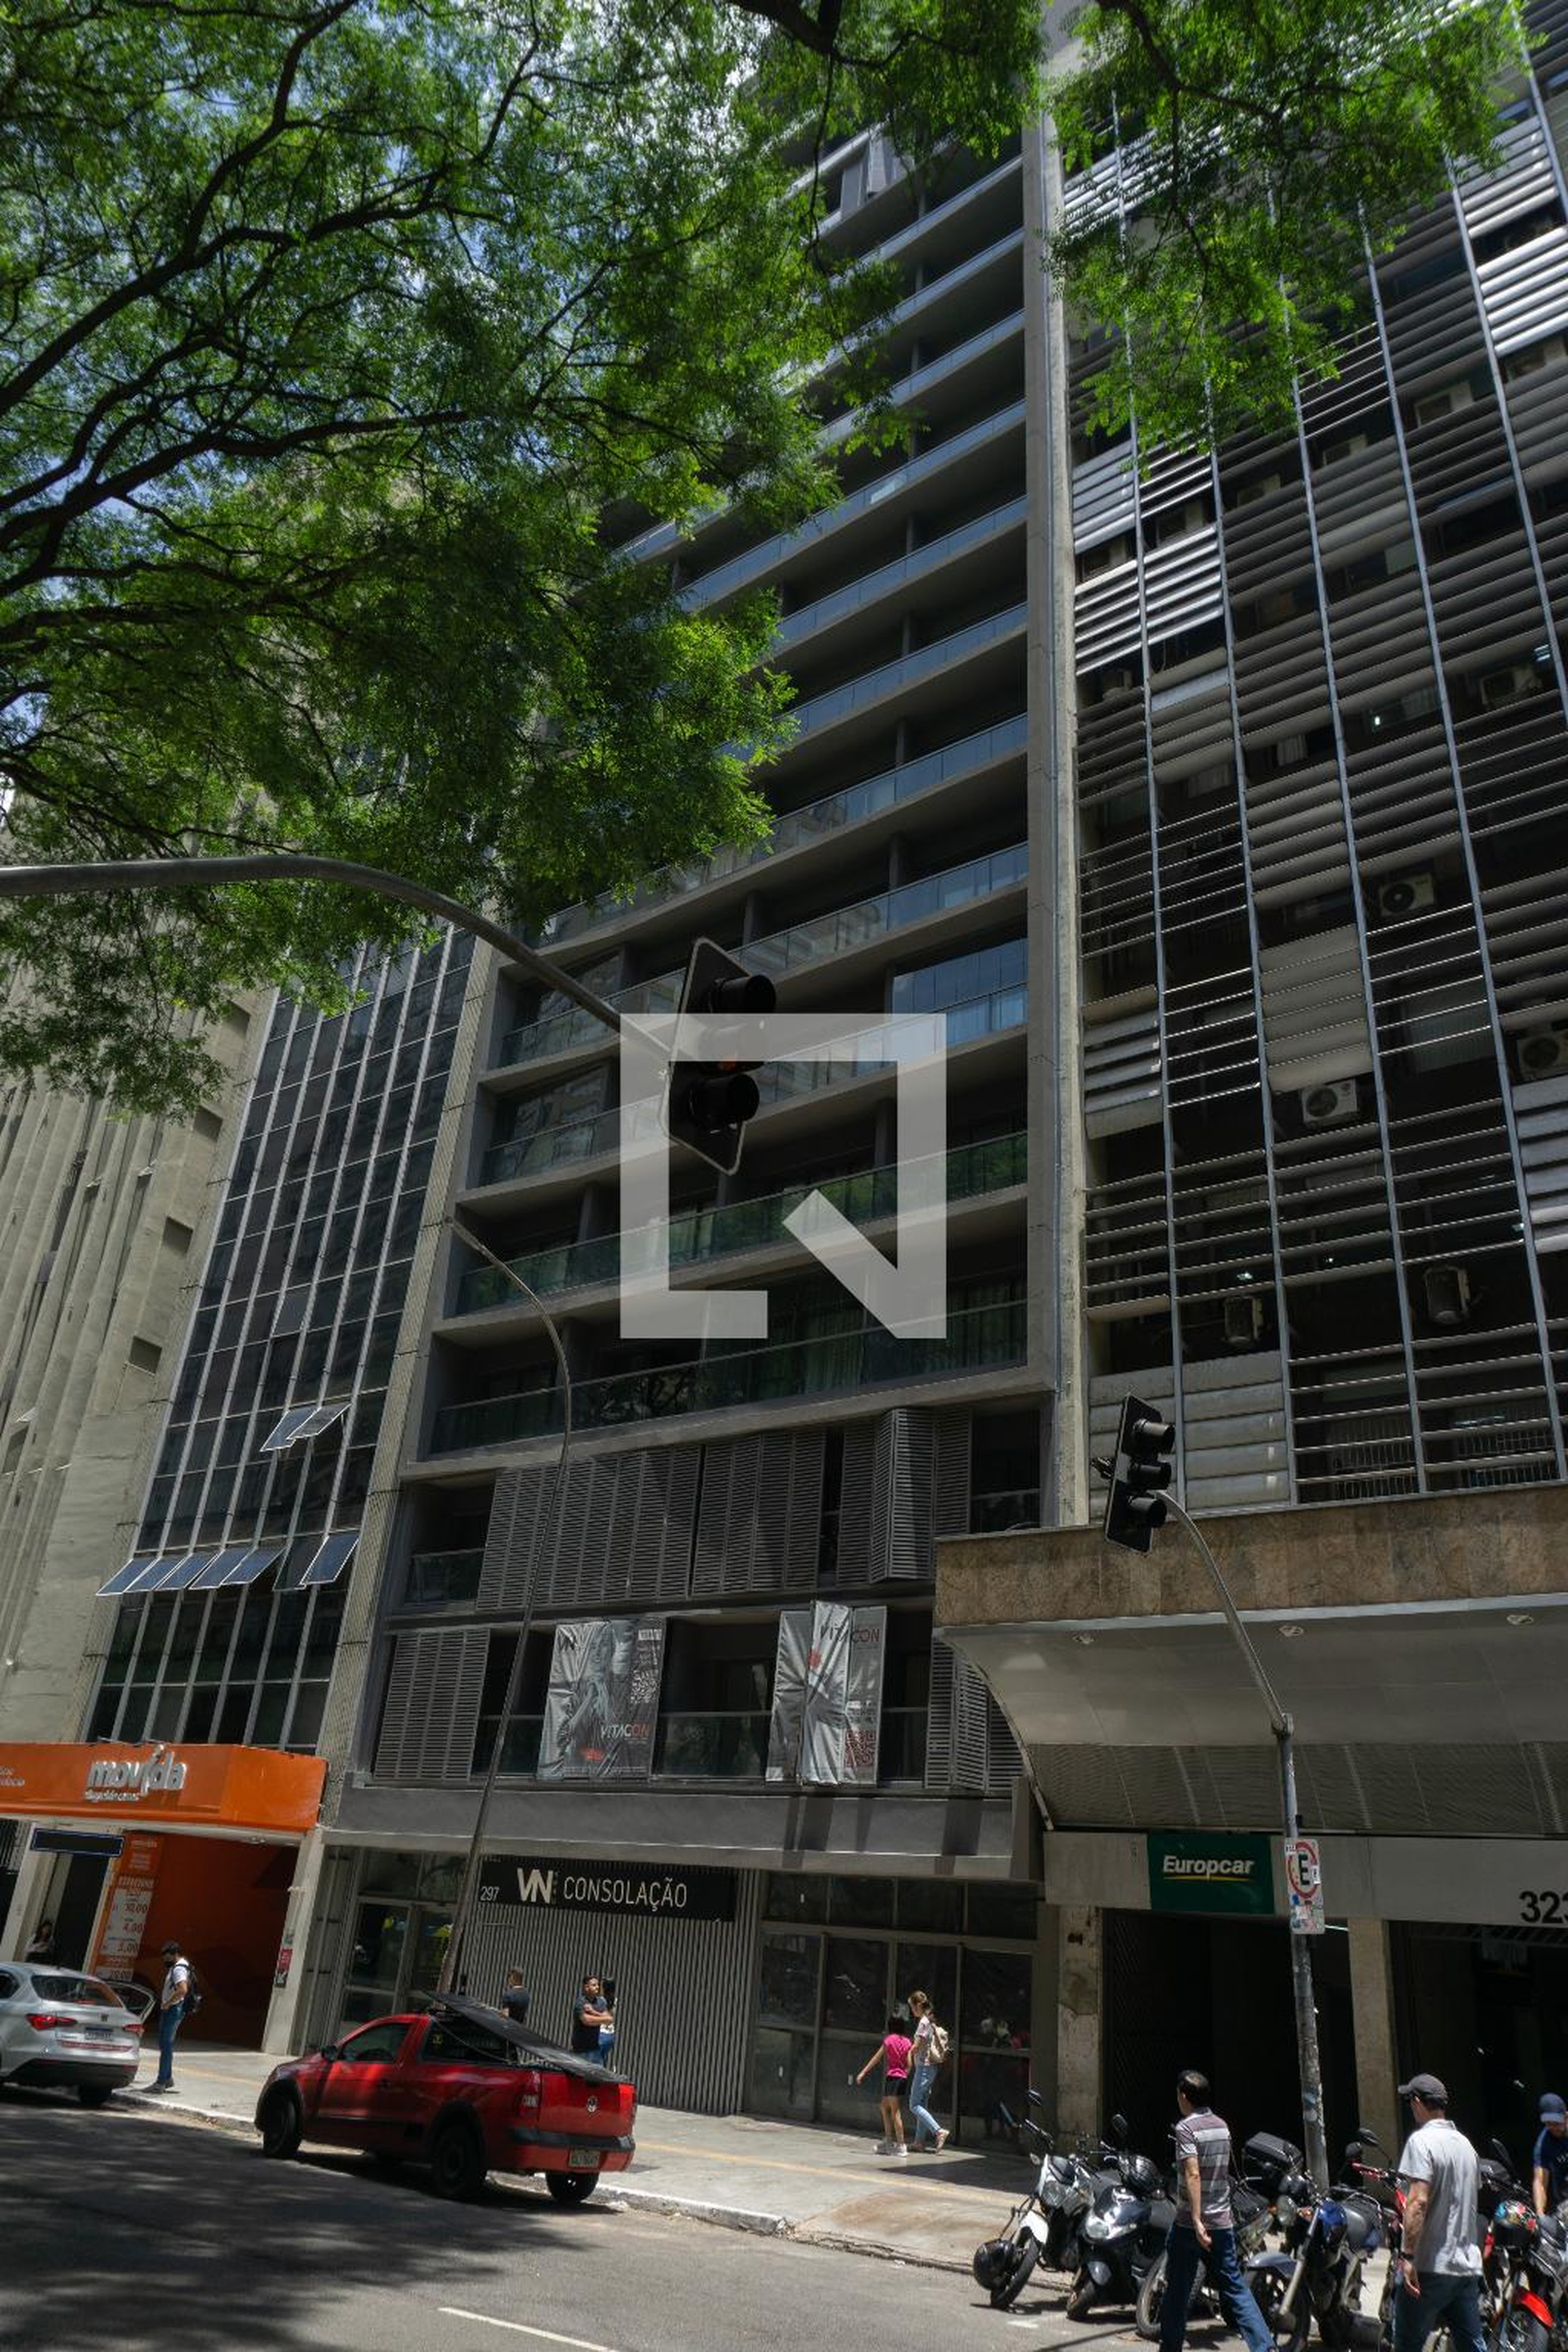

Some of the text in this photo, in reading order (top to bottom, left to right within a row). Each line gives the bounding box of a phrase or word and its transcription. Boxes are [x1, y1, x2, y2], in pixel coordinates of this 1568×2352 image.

[600, 1723, 650, 1739] VITACON
[87, 1744, 187, 1797] movida
[1163, 1855, 1255, 1880] Europcar
[1298, 1854, 1310, 1885] E
[480, 1886, 499, 1901] 297
[563, 1876, 687, 1911] CONSOLAÇÃO
[1519, 1890, 1568, 1923] 32
